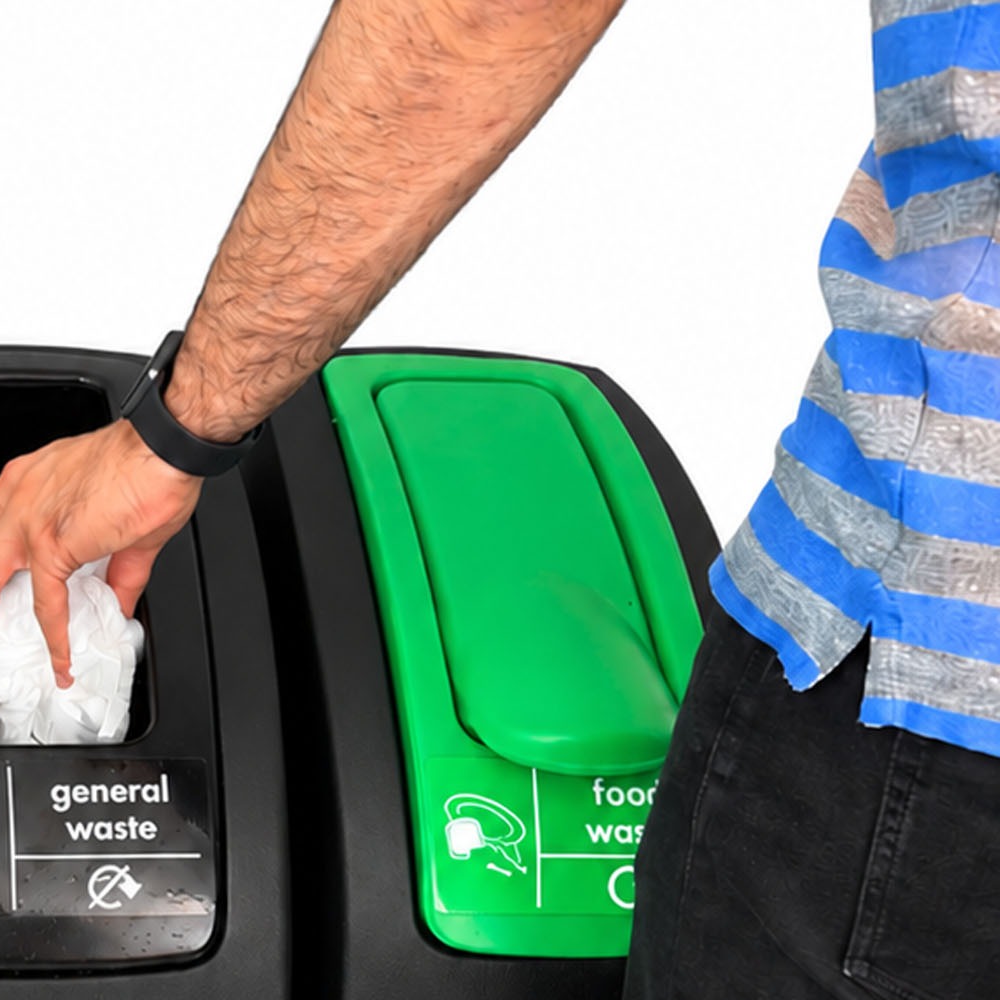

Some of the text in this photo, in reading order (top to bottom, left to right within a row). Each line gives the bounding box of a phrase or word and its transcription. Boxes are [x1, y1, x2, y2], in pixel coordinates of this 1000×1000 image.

[50, 773, 169, 812] general
[65, 817, 158, 841] waste
[585, 823, 645, 844] was
